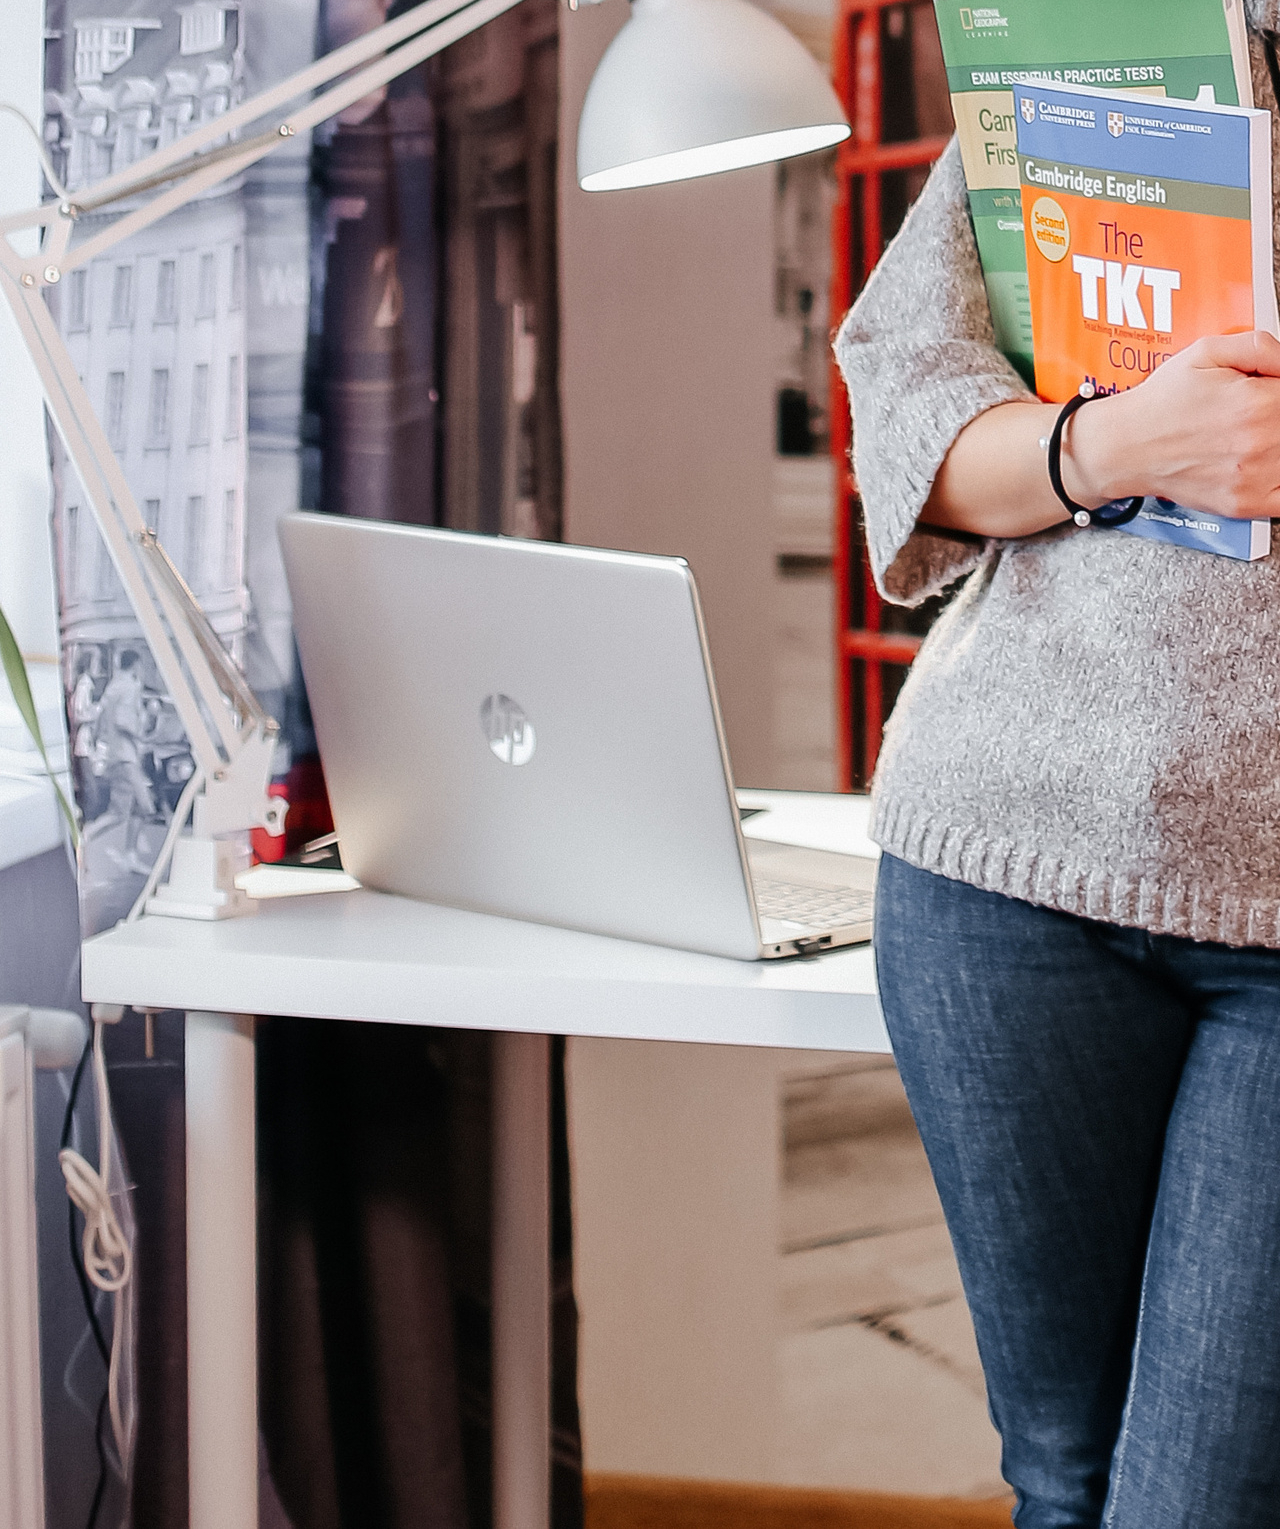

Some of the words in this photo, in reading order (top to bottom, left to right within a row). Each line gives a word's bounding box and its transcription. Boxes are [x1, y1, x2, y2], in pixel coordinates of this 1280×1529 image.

[970, 71, 1001, 85] EXAM
[1001, 69, 1062, 85] ESSENTIALS
[1064, 67, 1122, 84] PRACTICE
[1124, 65, 1164, 81] TESTS
[1038, 101, 1096, 121] CAMBRIDGE
[1124, 115, 1164, 128] UNIVERSITY
[1170, 122, 1212, 135] CAMBRIDGE
[1025, 160, 1103, 198] Cambridge
[1105, 175, 1167, 204] English
[1034, 211, 1066, 231] Second
[1036, 229, 1066, 247] edition
[1098, 221, 1144, 259] The
[1072, 254, 1181, 334] TKT
[1083, 320, 1113, 338] Teaching
[1113, 327, 1155, 345] Knowledge
[1155, 333, 1172, 345] Test
